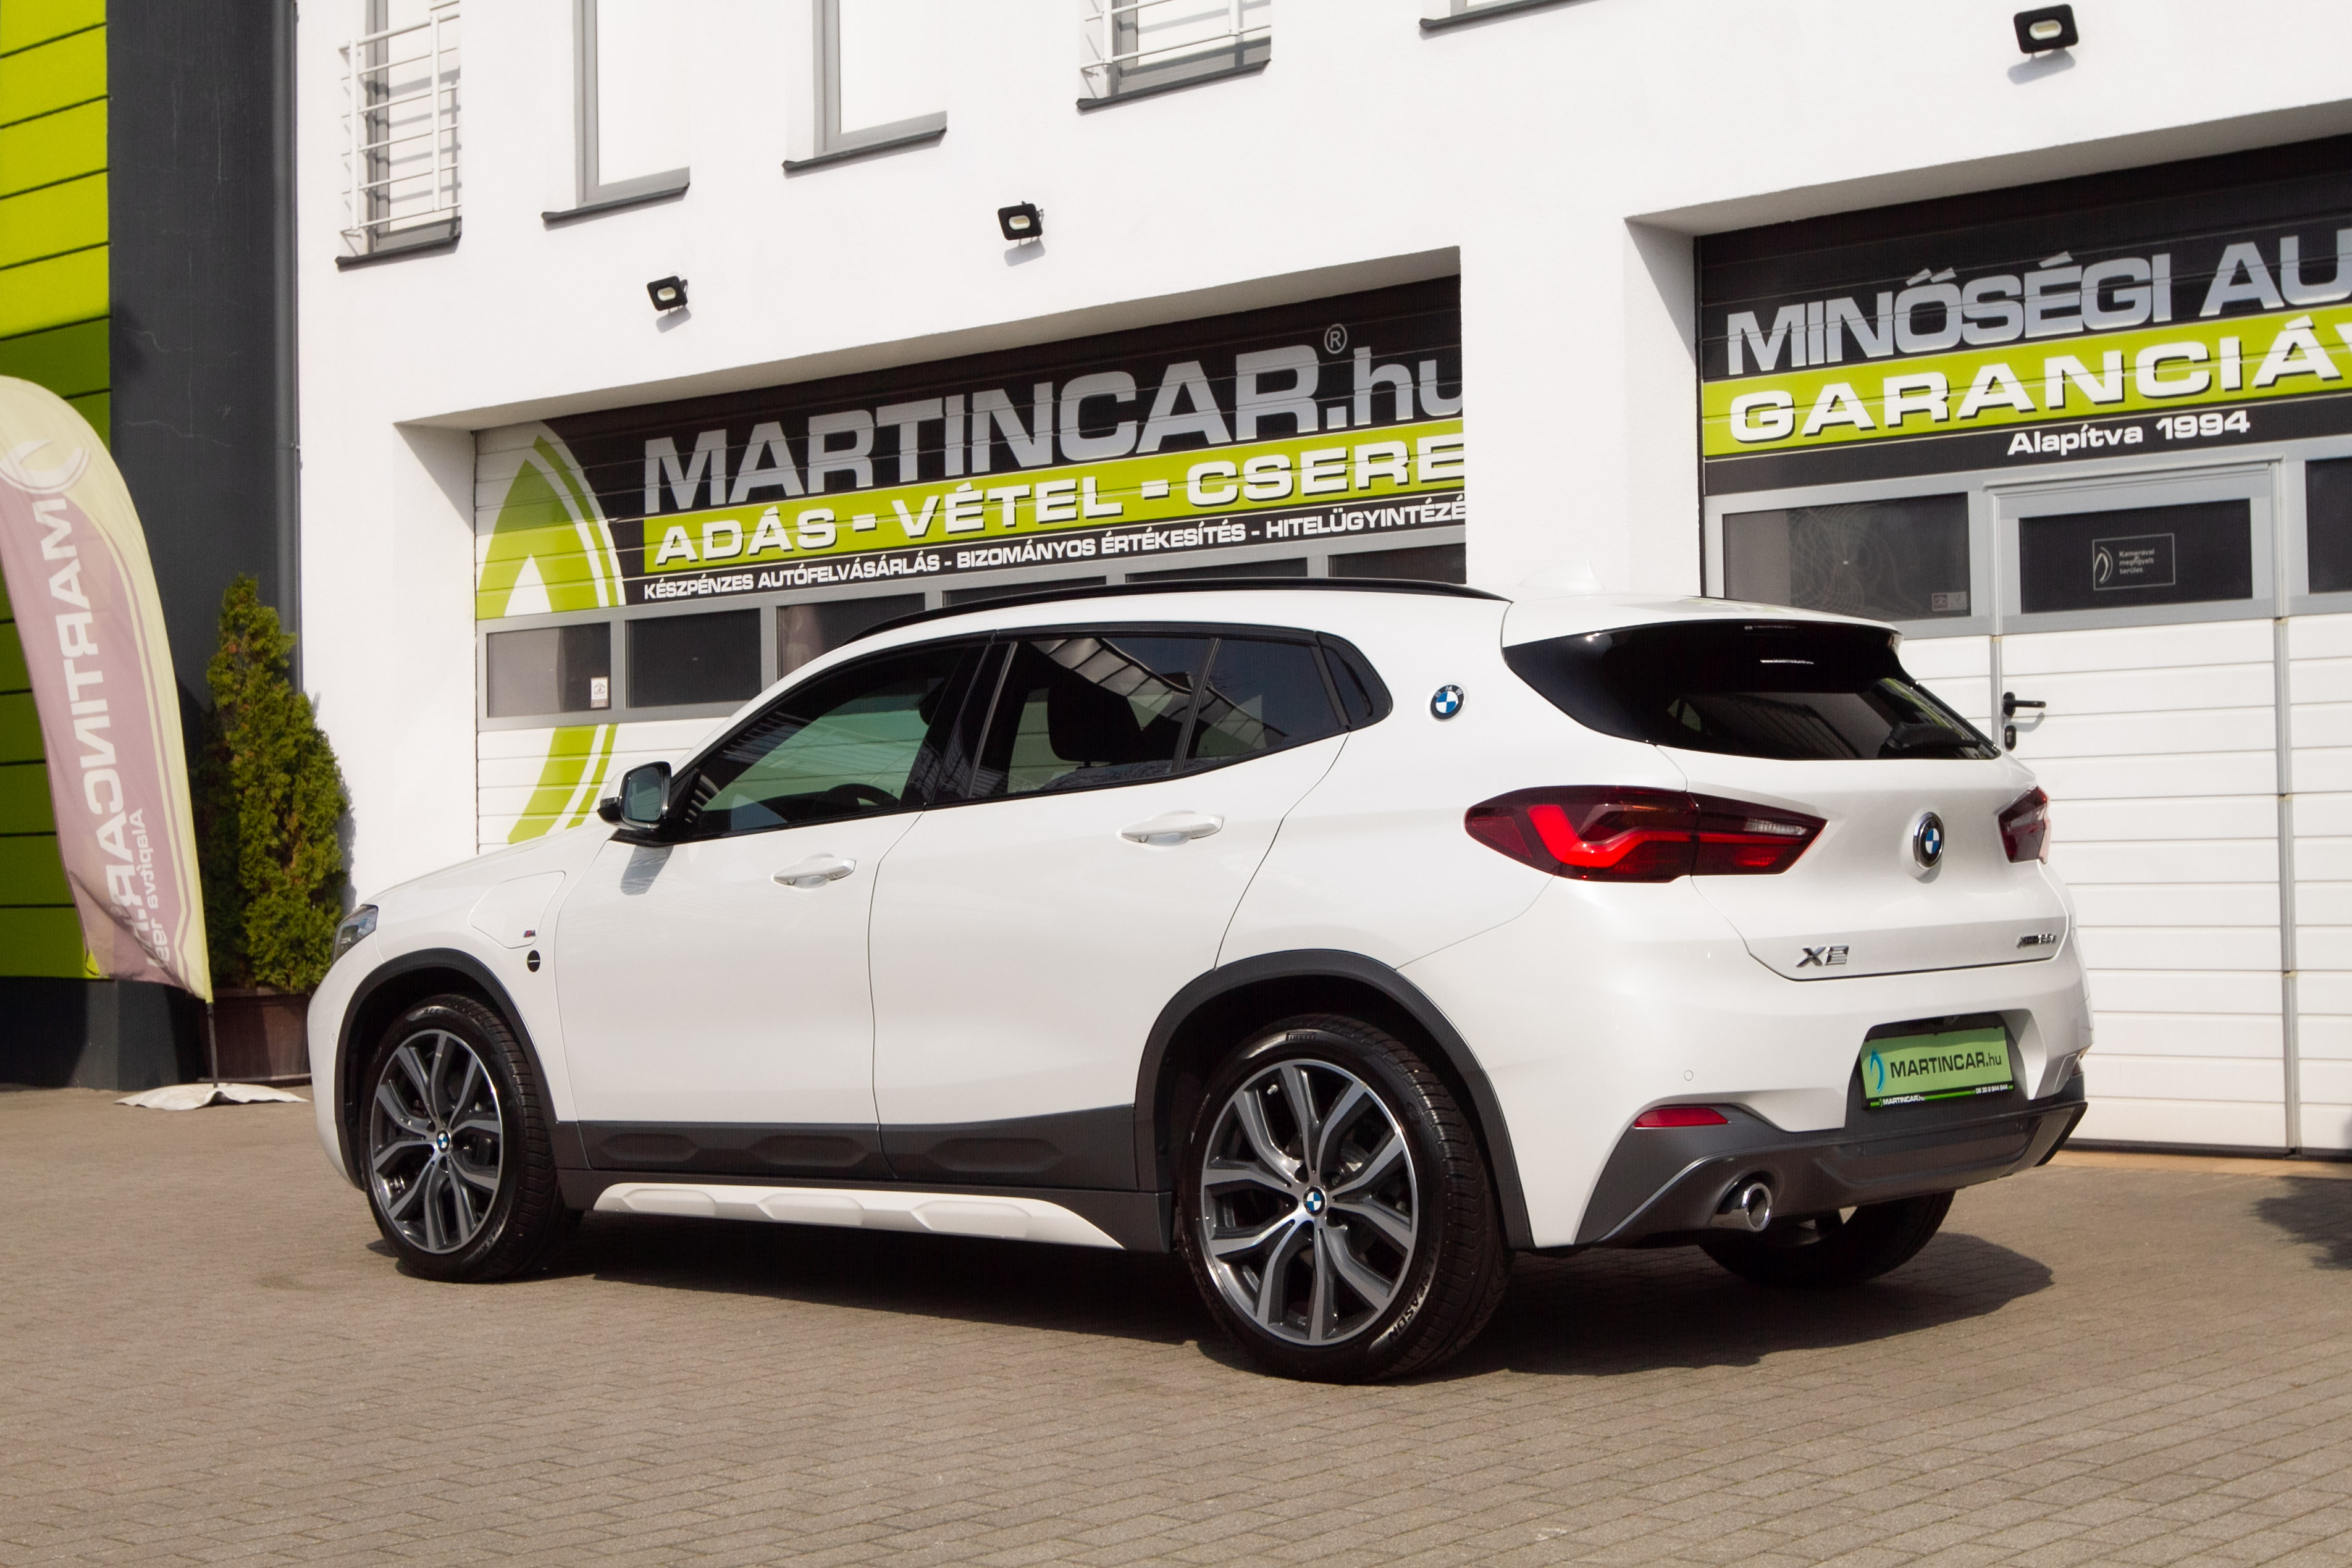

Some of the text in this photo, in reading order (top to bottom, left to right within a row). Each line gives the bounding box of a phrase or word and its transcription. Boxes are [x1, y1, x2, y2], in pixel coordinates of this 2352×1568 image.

[1728, 251, 2171, 375] MINŐSÉGI
[1729, 314, 2352, 445] GARANCIÁ
[2007, 410, 2250, 456] Alapítva 1994
[644, 570, 754, 600] KÉSZPÉNZES
[758, 551, 940, 589] AUTÓFELVÁSÁRLÁS
[957, 536, 1096, 569] BIZOMÁNYOS
[1101, 519, 1246, 555] ÉRTÉKESÍTÉS
[1266, 493, 1466, 539] HITELÜGYINTÉZÉ
[655, 506, 836, 566] ADÁS
[892, 476, 1124, 538] VÉTEL
[1186, 432, 1464, 508] CSERE
[1796, 945, 1849, 968] X2
[1890, 1051, 2002, 1078] MARTINCAR.hu
